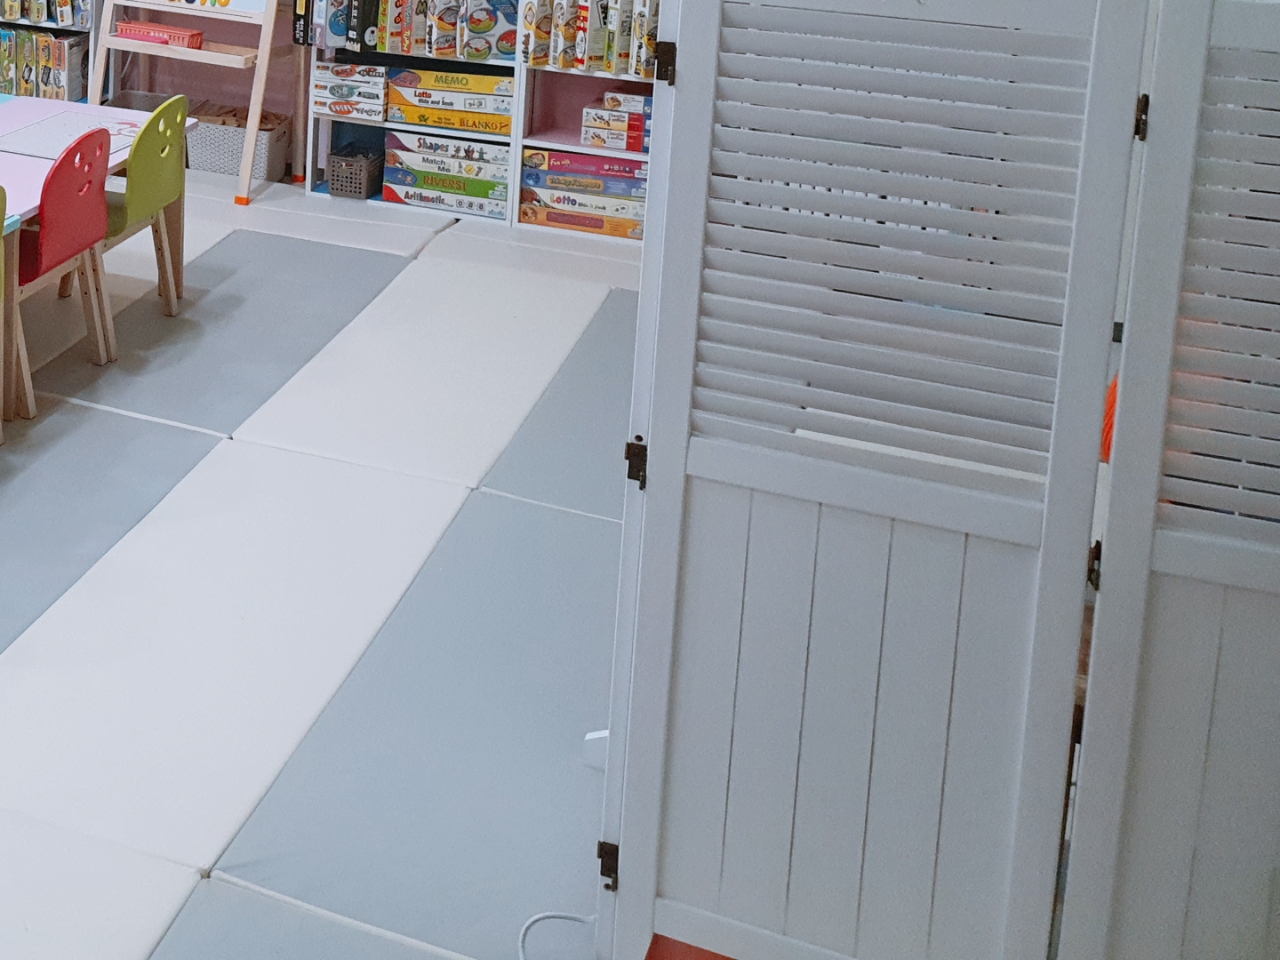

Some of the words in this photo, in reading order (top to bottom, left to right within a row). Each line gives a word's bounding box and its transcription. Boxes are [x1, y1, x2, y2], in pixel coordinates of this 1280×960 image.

[433, 74, 469, 87] MEMO
[417, 137, 450, 154] Shapes
[421, 156, 446, 166] Match
[549, 193, 577, 207] Lotto
